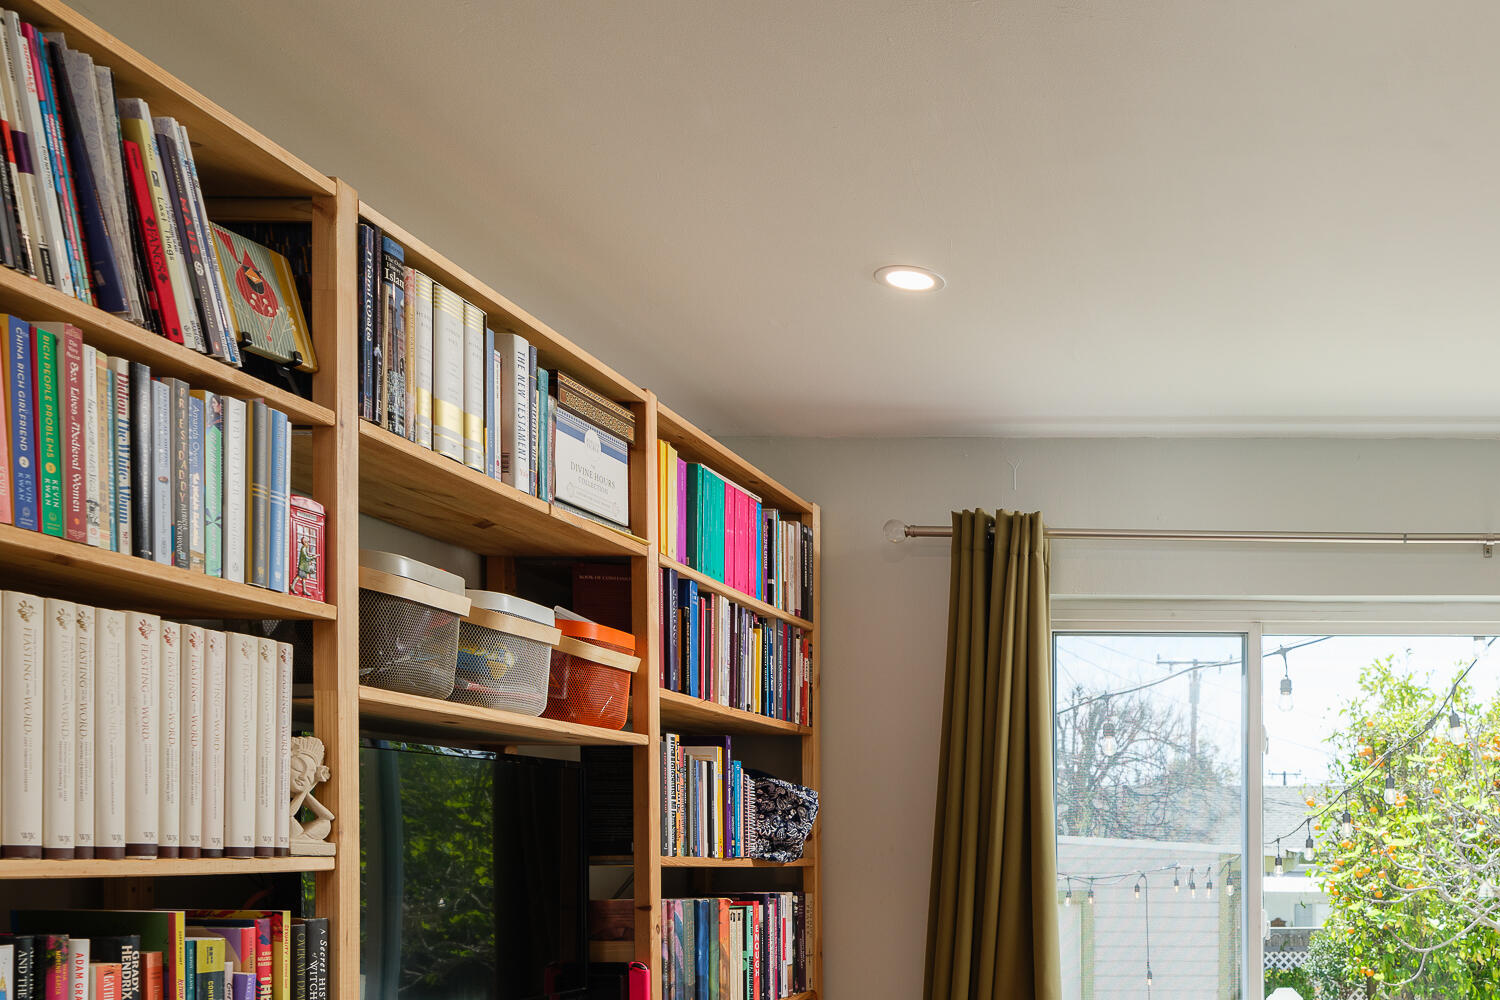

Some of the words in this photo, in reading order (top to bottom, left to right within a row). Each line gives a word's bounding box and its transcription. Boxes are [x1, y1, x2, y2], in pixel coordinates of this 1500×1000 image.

[157, 196, 168, 222] Last
[164, 229, 176, 263] Things
[179, 196, 200, 256] MAUS
[145, 236, 165, 268] FANGS
[15, 326, 24, 362] CHINA
[42, 335, 51, 360] RICH
[517, 350, 526, 371] THE
[16, 363, 25, 388] RICH
[43, 362, 51, 402] PEOPLE
[70, 362, 80, 382] Sex
[517, 373, 526, 396] NEW
[70, 387, 81, 415] Lives
[116, 372, 130, 416] Didion
[17, 389, 28, 451] GIRLFRIEND
[45, 404, 55, 458] PROBLEMS
[117, 417, 130, 443] The
[191, 404, 201, 440] Amanda
[517, 402, 526, 462] TESTAMENT
[71, 422, 83, 470] Medieval
[117, 443, 130, 481] White
[176, 387, 187, 502] PRIESTDADDY
[72, 473, 83, 512] Women
[570, 460, 593, 479] DIVINE
[594, 472, 616, 489] HOURS
[119, 484, 130, 525] Album
[17, 949, 28, 974] AND
[74, 952, 84, 980] ADAM
[121, 945, 131, 1000] HENDRIX
[131, 950, 140, 992] GRADY
[318, 939, 328, 973] Secret
[17, 976, 28, 1000] THE
